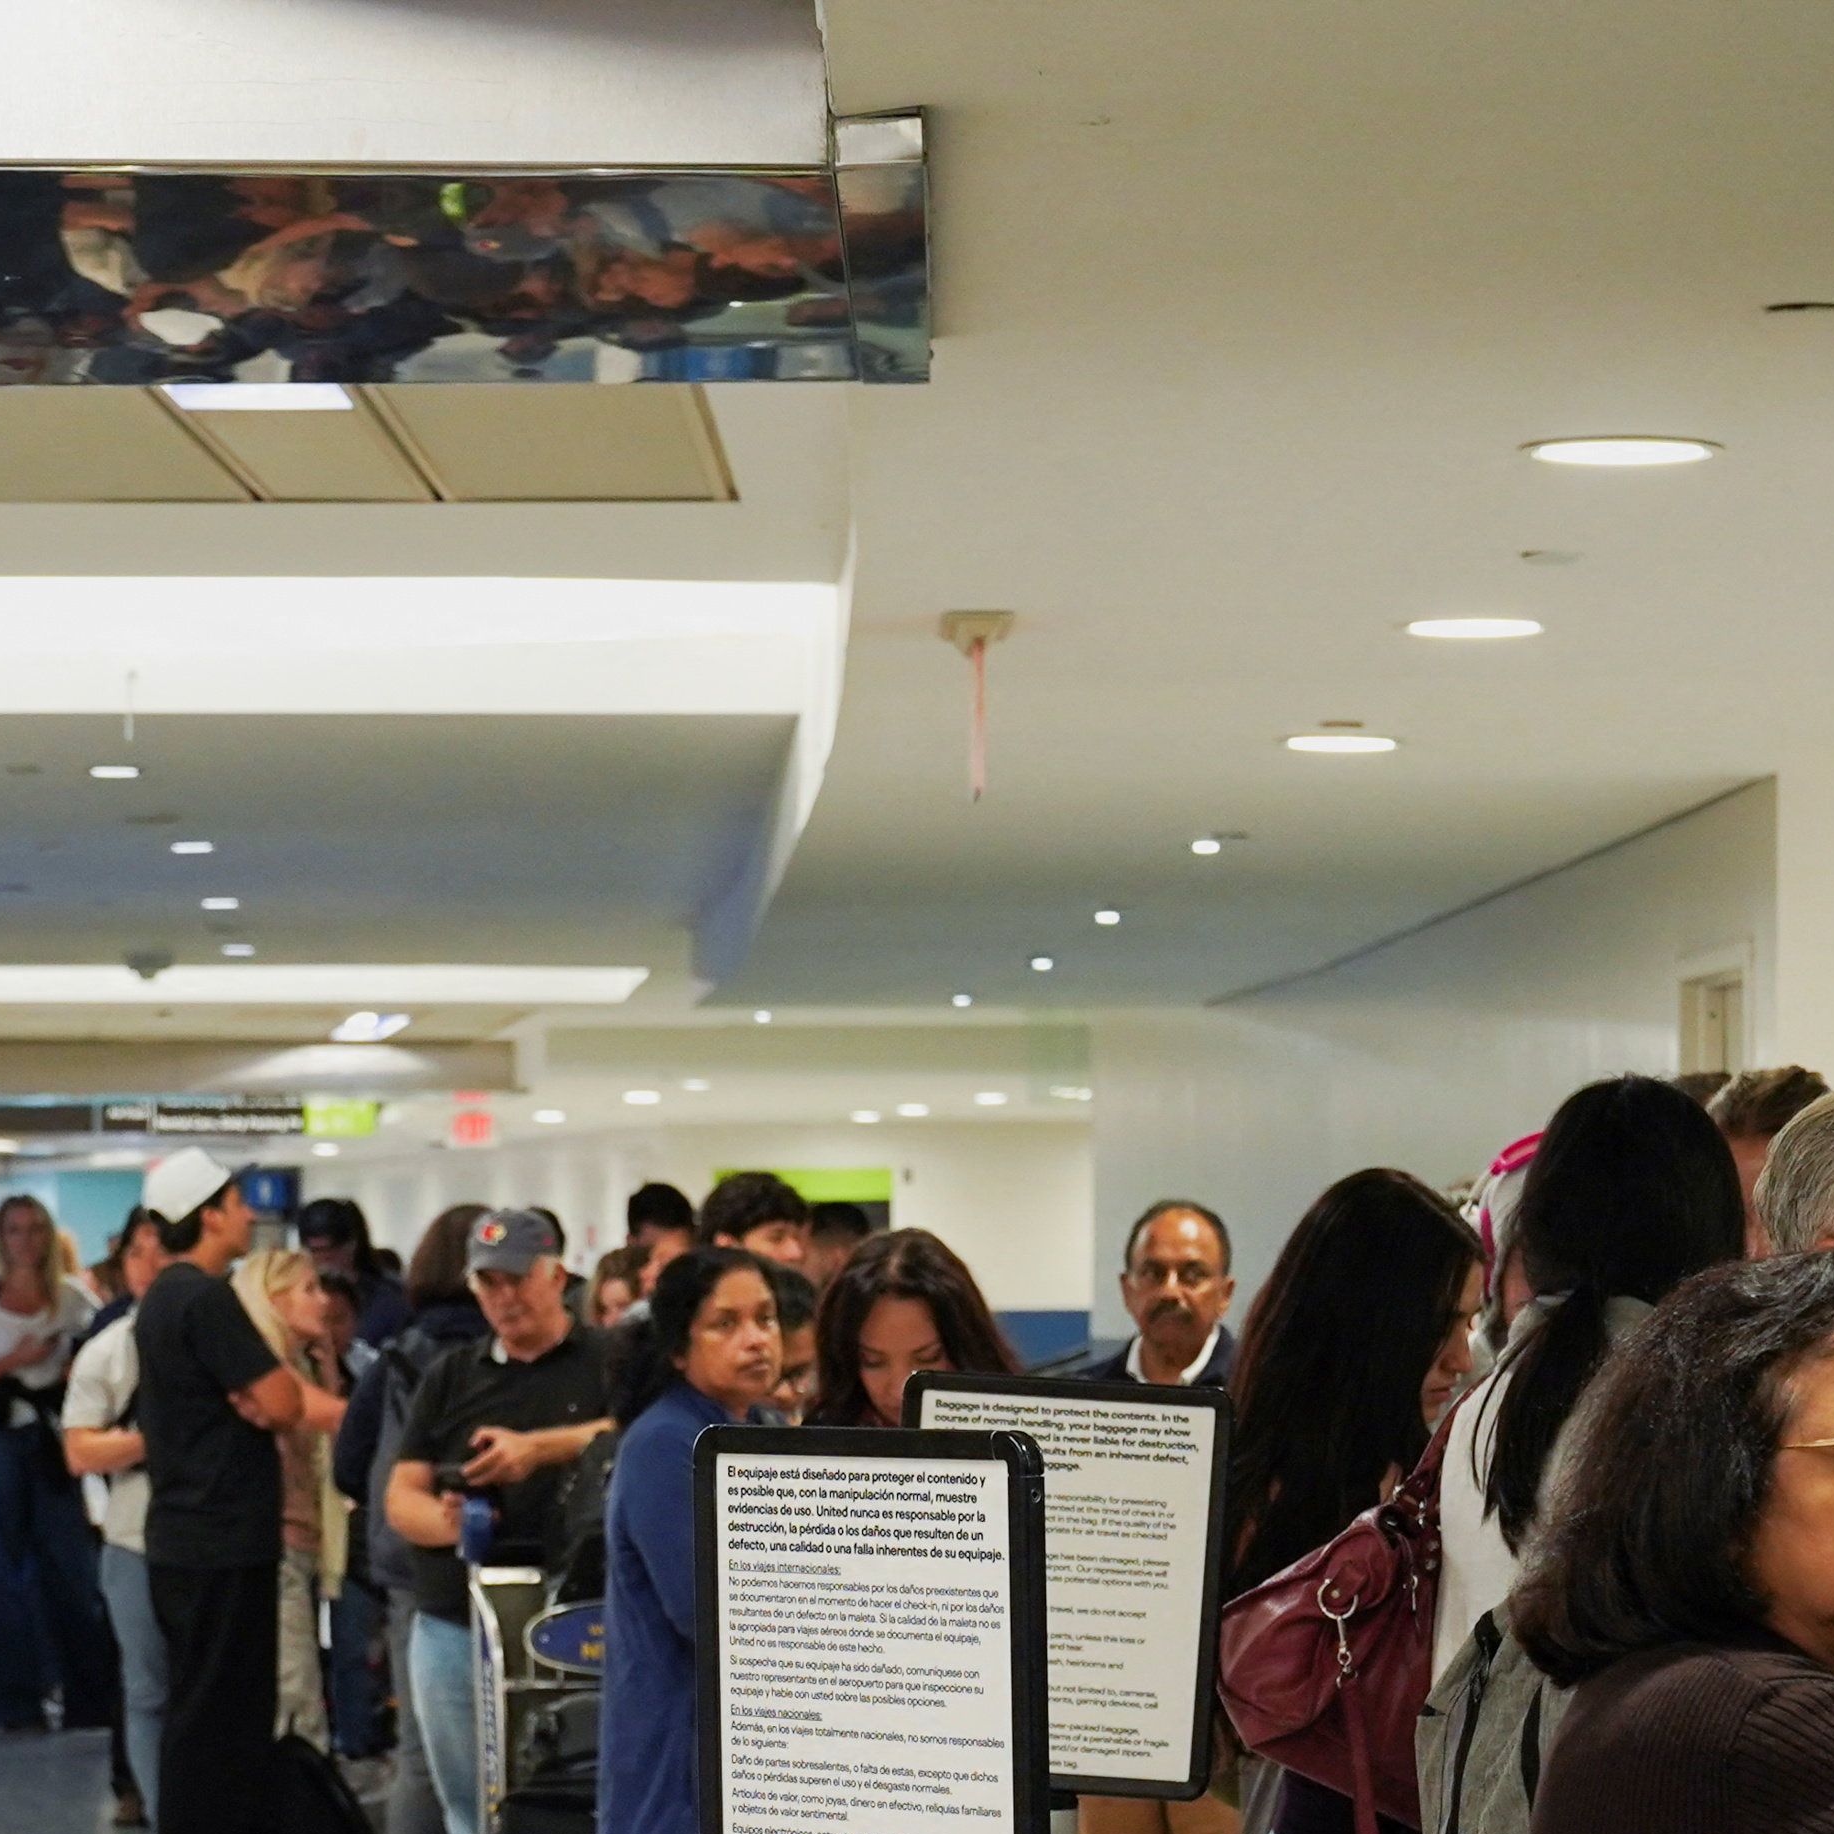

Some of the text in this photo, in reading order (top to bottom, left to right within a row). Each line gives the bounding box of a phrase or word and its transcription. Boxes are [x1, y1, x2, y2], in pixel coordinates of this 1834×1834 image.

[727, 1465, 985, 1488] El equipaje está diseñado para proteger el contenido y
[727, 1486, 739, 1496] es
[740, 1484, 774, 1499] posible
[798, 1488, 817, 1498] con
[818, 1486, 827, 1498] la
[829, 1487, 894, 1502] manipulación
[935, 1490, 977, 1503] muestre
[727, 1502, 778, 1515] evidencias
[779, 1503, 792, 1516] de
[816, 1504, 848, 1517] United
[850, 1508, 880, 1518] nunca
[881, 1509, 893, 1519] es
[895, 1508, 956, 1523] responsable
[957, 1511, 975, 1524] por
[977, 1509, 985, 1522] la
[789, 1521, 797, 1534] la
[799, 1522, 836, 1537] pérdida
[837, 1526, 844, 1535] o
[845, 1523, 859, 1536] los
[861, 1524, 891, 1537] daños
[893, 1528, 912, 1540] que
[913, 1526, 954, 1539] resulten
[955, 1527, 969, 1540] de
[971, 1530, 983, 1540] un
[769, 1542, 787, 1552] una
[789, 1540, 824, 1553] calidad
[825, 1544, 832, 1553] o
[833, 1544, 851, 1554] una
[853, 1542, 874, 1555] falla
[875, 1542, 928, 1557] inherentes
[929, 1544, 943, 1557] de
[944, 1548, 956, 1558] su
